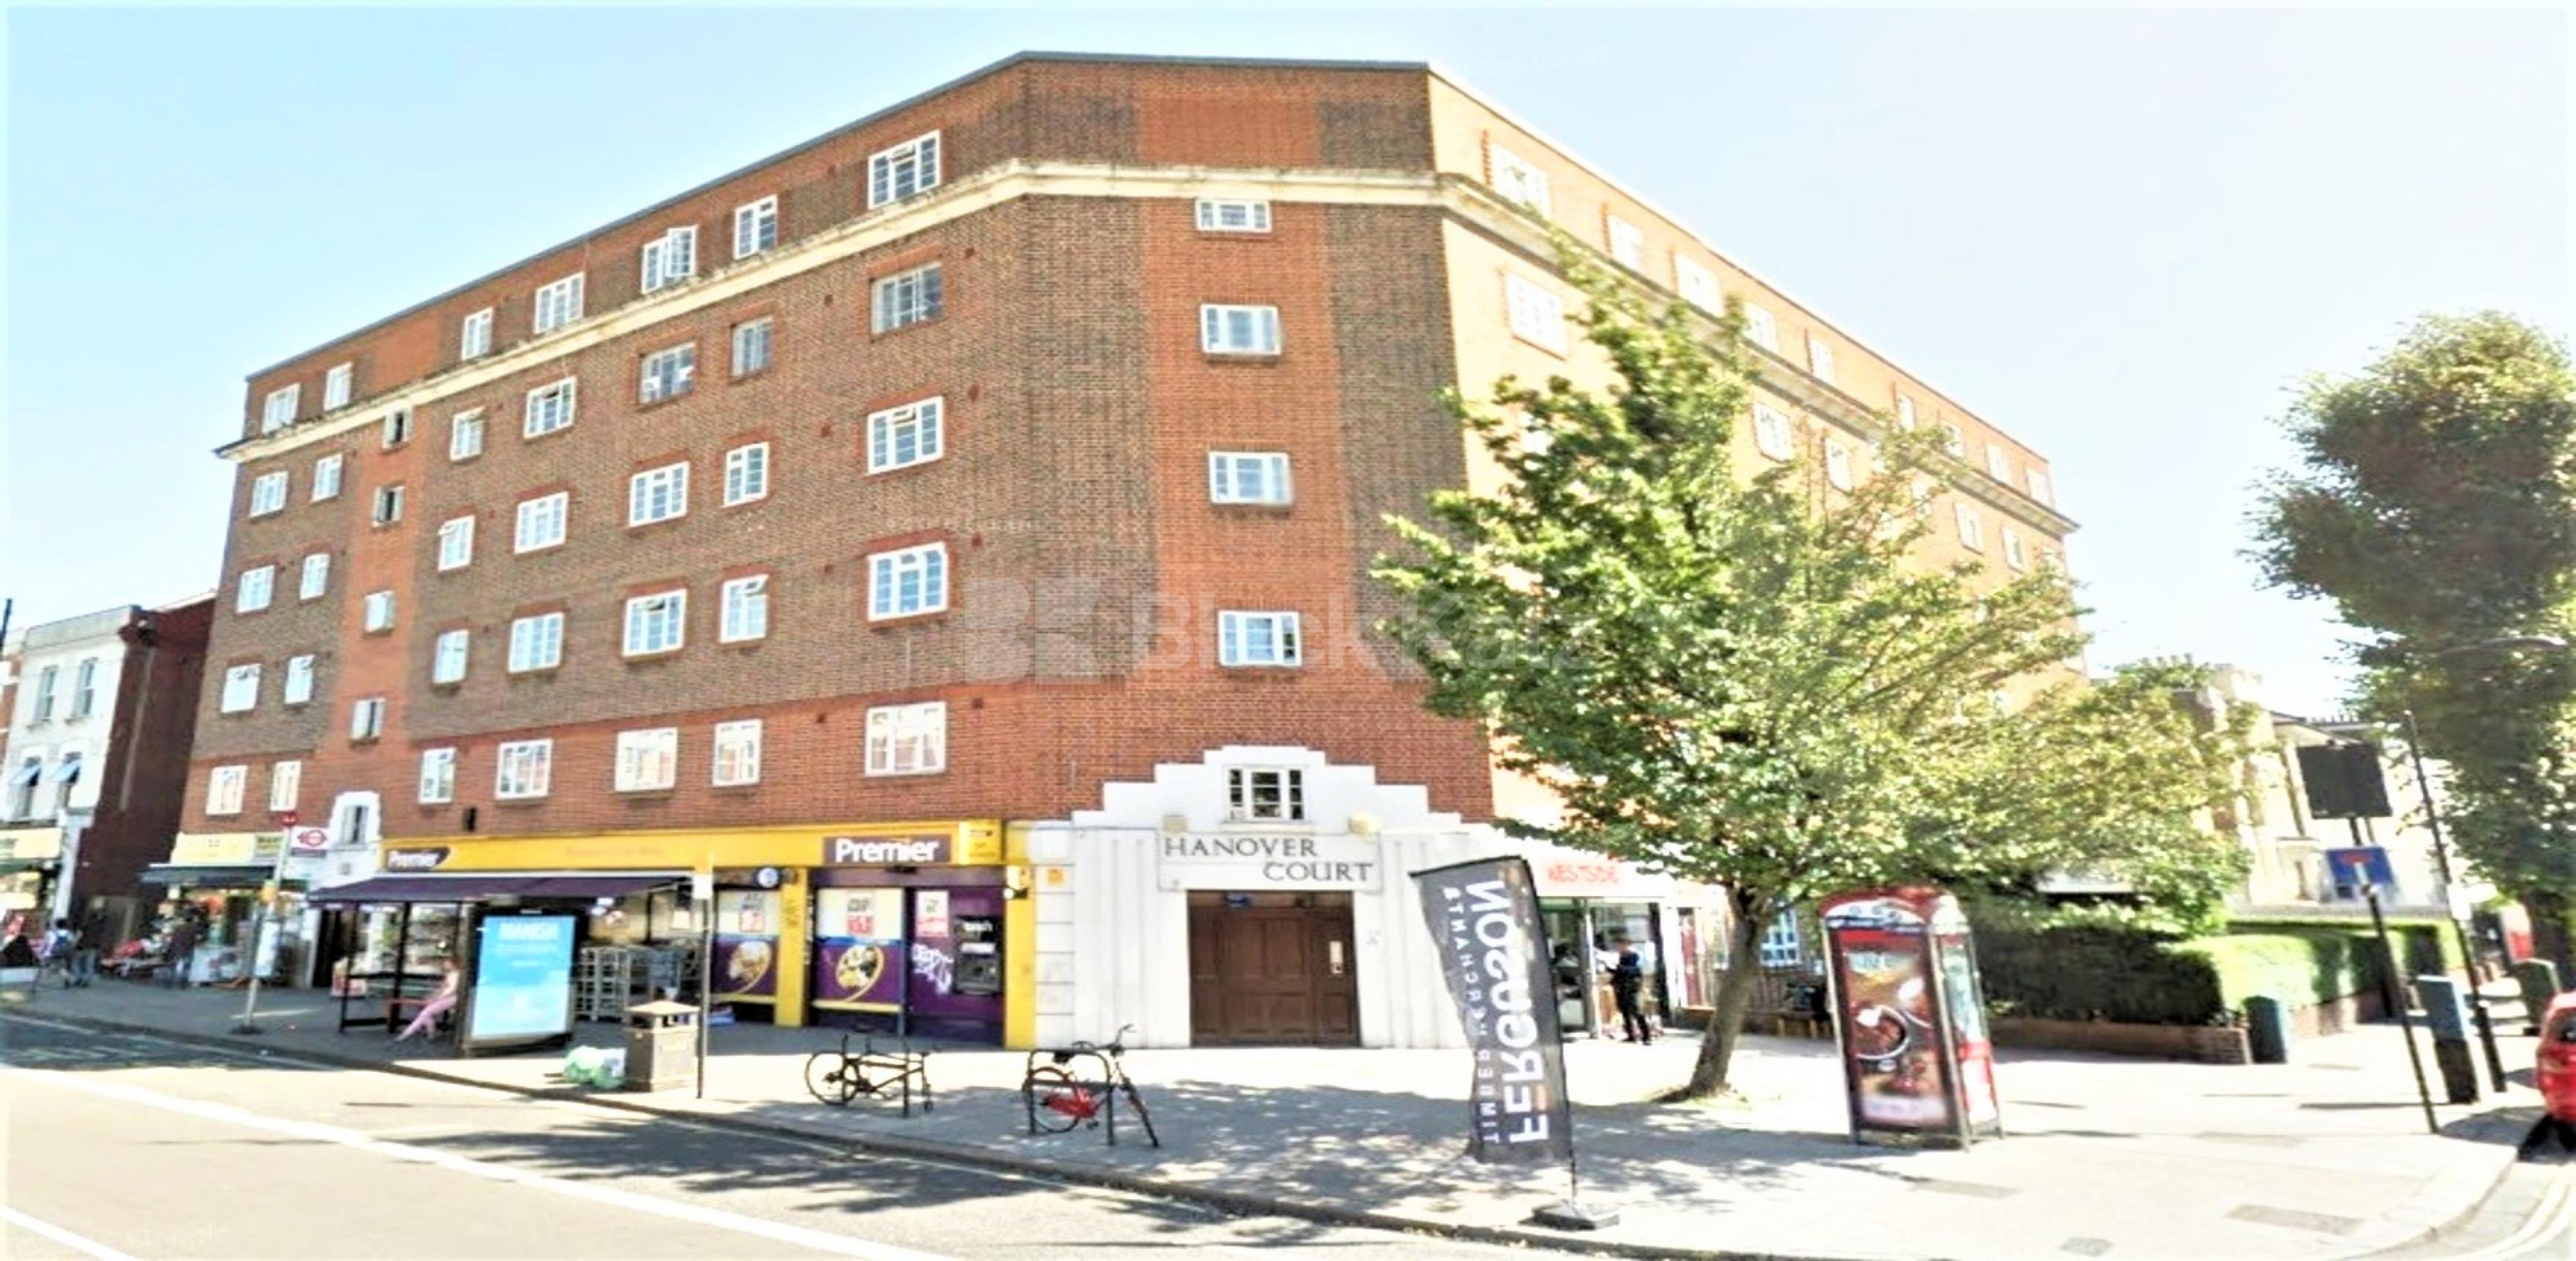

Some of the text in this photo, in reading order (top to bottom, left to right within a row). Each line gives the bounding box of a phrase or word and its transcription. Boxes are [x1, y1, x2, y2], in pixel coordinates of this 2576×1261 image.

[836, 838, 939, 863] Premier
[1165, 837, 1317, 856] HANOVER
[1263, 861, 1373, 881] COURT
